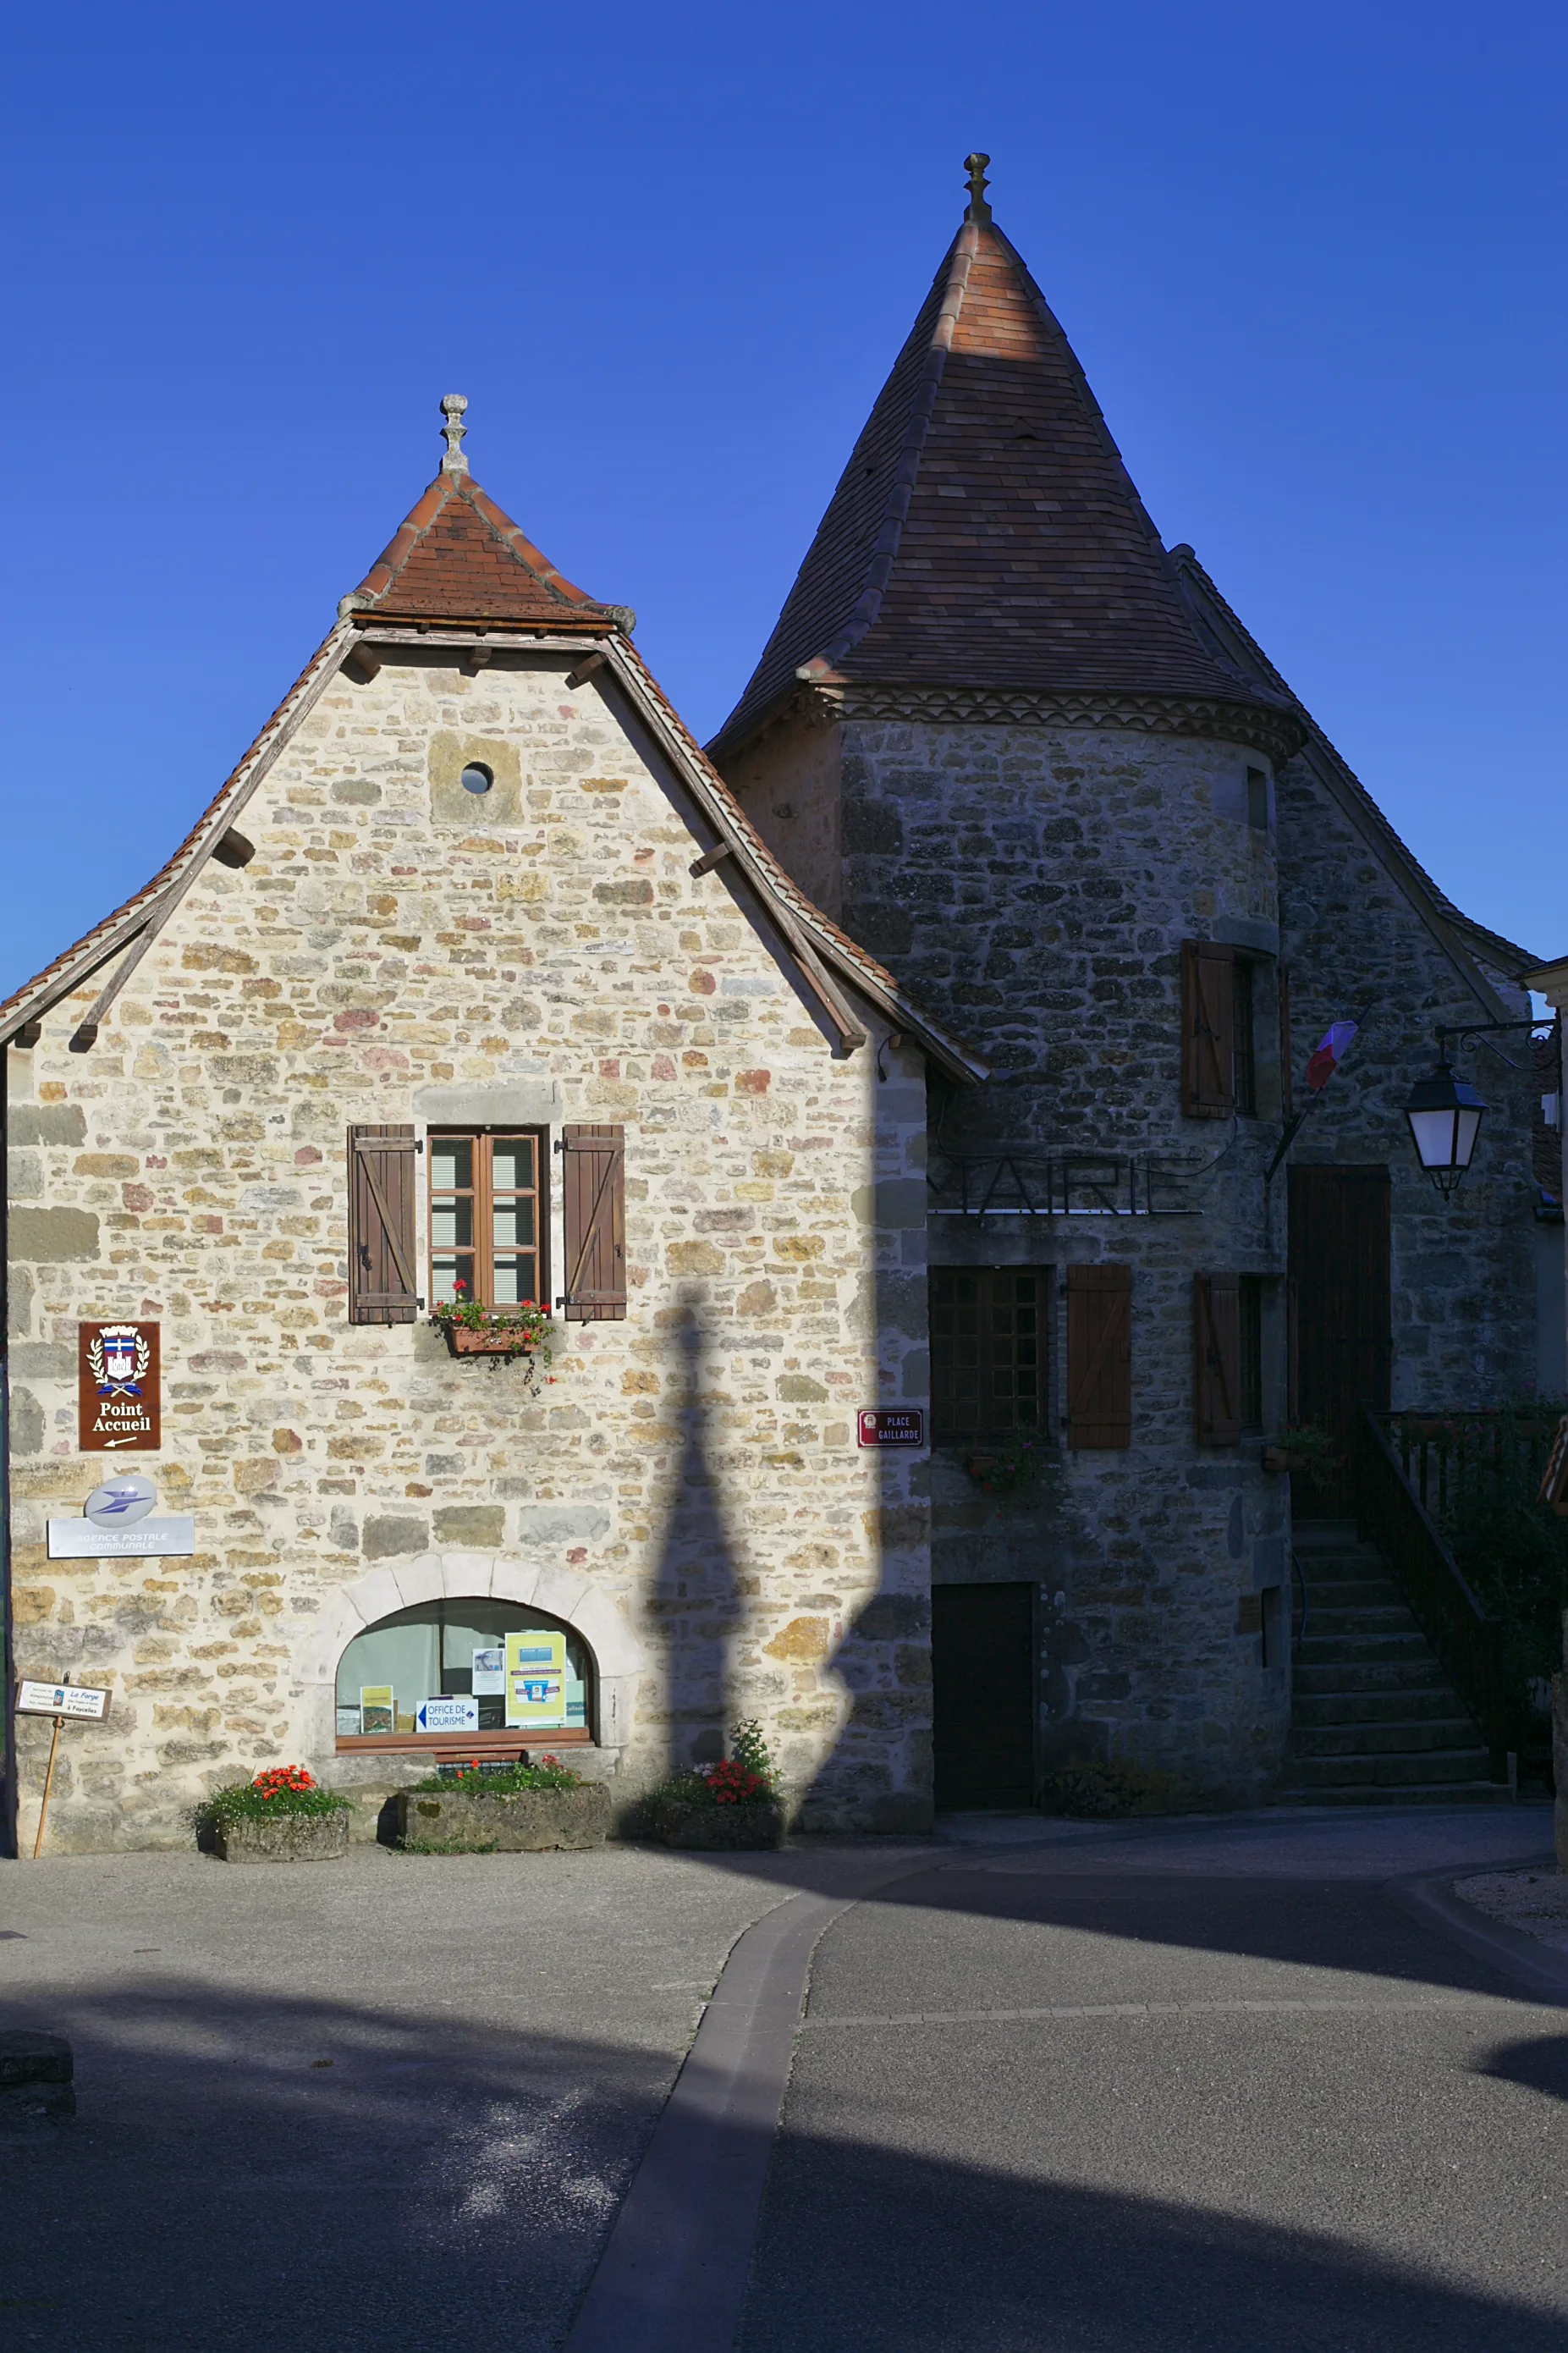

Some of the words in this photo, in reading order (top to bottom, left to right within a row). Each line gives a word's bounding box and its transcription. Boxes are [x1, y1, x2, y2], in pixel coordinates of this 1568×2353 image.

[100, 1402, 143, 1417] Point
[92, 1417, 151, 1432] Accueil
[887, 1417, 910, 1426] PLACE
[878, 1430, 919, 1440] GAILLARDE
[75, 1533, 119, 1543] AGENCE
[122, 1533, 168, 1541] POSTALE
[90, 1541, 156, 1551] COMMUNALE
[80, 1691, 99, 1701] Forge
[72, 1705, 97, 1714] Faycelles
[427, 1705, 454, 1715] OFFICE
[455, 1705, 465, 1714] DE
[428, 1716, 465, 1726] TOURISME
